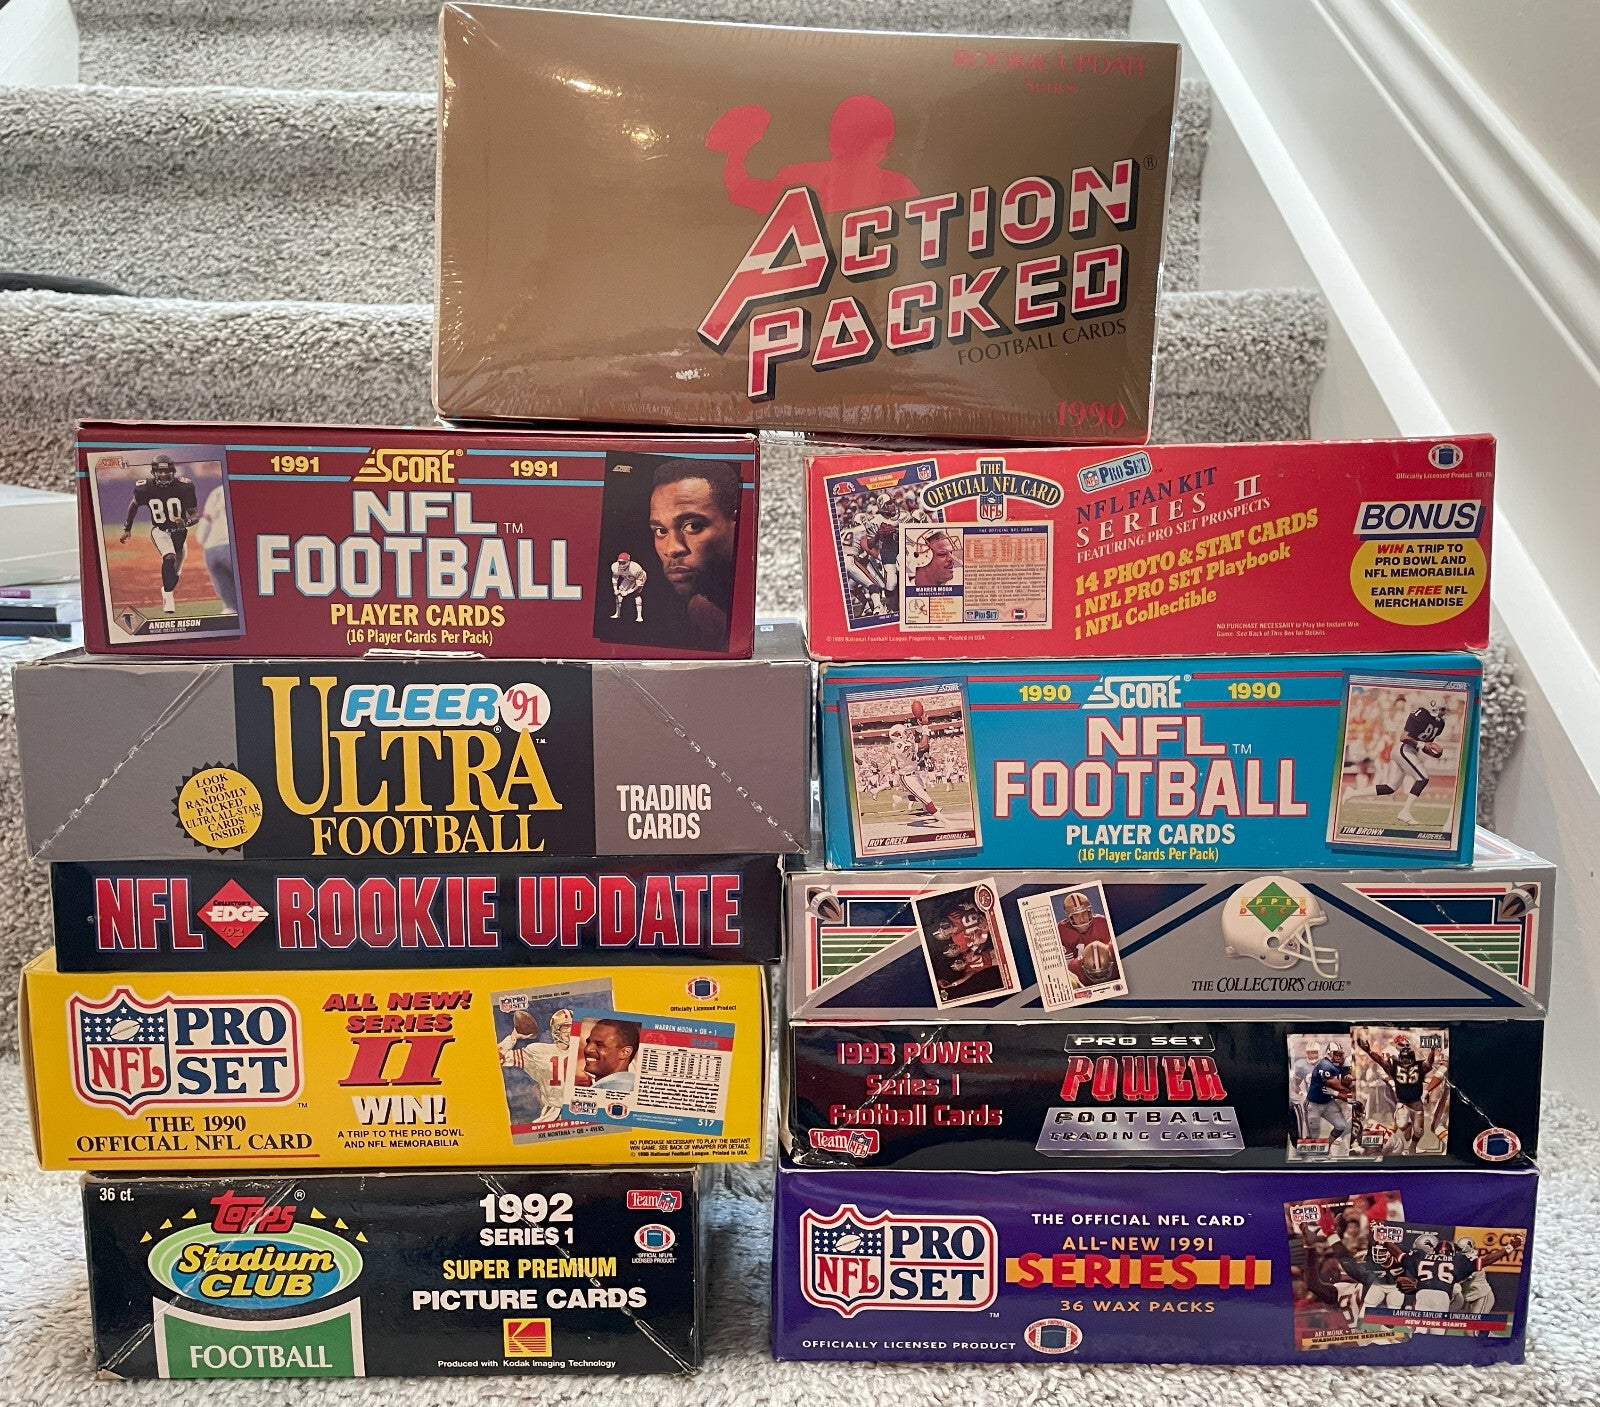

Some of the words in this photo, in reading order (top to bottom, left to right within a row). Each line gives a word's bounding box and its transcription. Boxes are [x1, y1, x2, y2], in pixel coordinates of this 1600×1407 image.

[698, 158, 1139, 353] ACTION
[747, 243, 1128, 402] PACKED
[957, 334, 1058, 366] FOOTBALL
[1062, 318, 1127, 347] CARDS
[1056, 400, 1127, 430] 1990
[270, 456, 321, 473] 1991
[510, 460, 559, 478] 1991
[980, 463, 1002, 475] THE
[1099, 463, 1124, 484] PRO
[1122, 455, 1149, 476] SET
[927, 476, 989, 506] OFFICIAL
[992, 476, 1018, 494] NFL
[1021, 479, 1059, 505] CARD
[1076, 496, 1124, 524] NFL
[1128, 480, 1172, 510] FAN
[1178, 466, 1218, 494] KIT
[352, 490, 498, 536] NFL
[1076, 492, 1206, 549] SERIES
[1234, 474, 1262, 502] II
[1361, 503, 1477, 530] BONUS
[1076, 532, 1144, 564] FEATURING
[1147, 525, 1173, 544] PRO
[1175, 517, 1201, 535] SET
[1201, 497, 1271, 528] PROSPECTS
[1076, 571, 1099, 596] 14
[1103, 551, 1176, 590] PHOTO
[1178, 548, 1193, 566] &
[1196, 529, 1246, 561] STAT
[1248, 508, 1319, 547] CARDS
[1377, 544, 1404, 554] WIN
[1405, 544, 1415, 554] A
[1417, 544, 1445, 553] TRIP
[1447, 543, 1464, 553] TO
[257, 535, 583, 600] FOOTBALL
[1364, 569, 1388, 578] NFL
[1390, 567, 1475, 577] MEMORABILIA
[1375, 556, 1400, 566] PRO
[1403, 556, 1440, 565] BOWL
[1441, 556, 1467, 565] AND
[1085, 592, 1122, 617] NFL
[1124, 578, 1165, 605] PRO
[1169, 569, 1204, 592] SET
[1206, 541, 1292, 582] Playbook
[1371, 587, 1404, 596] EARN
[1407, 585, 1442, 595] FREE
[1445, 585, 1468, 595] NFL
[1085, 613, 1123, 638] NFL
[1125, 586, 1217, 626] Collectible
[1374, 598, 1464, 608] MERCHANDISE
[330, 604, 420, 626] PLAYER
[425, 604, 506, 627] CARDS
[346, 629, 365, 645] (16
[366, 629, 402, 646] Player
[403, 629, 437, 644] Cards
[441, 629, 460, 644] Per
[462, 629, 493, 645] Pack)
[1019, 685, 1072, 702] 1990
[1228, 682, 1281, 699] 1990
[342, 684, 499, 726] FLEER
[506, 688, 542, 726] '91
[262, 676, 563, 816] ULTRA
[1086, 715, 1227, 757] NFL
[195, 773, 229, 788] LOOK
[203, 783, 226, 795] FOR
[994, 758, 1309, 818] FOOTBALL
[185, 787, 247, 809] RANDOMLY
[197, 797, 243, 816] PACKED
[616, 784, 712, 811] TRADING
[186, 815, 217, 829] ULTRA
[218, 803, 261, 821] ALL-STAR
[208, 816, 245, 832] CARDS
[627, 813, 700, 840] CARDS
[211, 825, 248, 841] INSIDE
[311, 814, 545, 857] FOOTBALL
[868, 838, 884, 847] ROY
[885, 836, 909, 846] GREEN
[1066, 824, 1152, 845] PLAYER
[1158, 823, 1236, 845] CARDS
[1342, 826, 1355, 835] TIM
[1355, 828, 1384, 836] BROWN
[1078, 848, 1095, 862] (16
[1098, 848, 1132, 863] Player
[1133, 848, 1166, 861] Cards
[1169, 848, 1187, 861] Per
[1188, 847, 1219, 862] Pack)
[95, 877, 205, 951] NFL
[276, 876, 499, 950] ROOKIE
[518, 875, 742, 948] UPDATE
[206, 906, 269, 922] EDGE
[1239, 907, 1307, 916] DECK
[1192, 980, 1214, 991] THE
[1217, 977, 1306, 992] COLLECTOR'S
[1308, 980, 1346, 991] CHOICE
[322, 992, 379, 1012] ALL
[385, 990, 473, 1011] NEW!
[345, 1012, 455, 1034] SERIES
[88, 1047, 165, 1094] NFL
[174, 1006, 287, 1046] PRO
[837, 1043, 896, 1064] 1993
[903, 1041, 993, 1064] POWER
[1074, 1037, 1136, 1046] PRO
[1151, 1036, 1204, 1046] SET
[338, 1036, 457, 1087] II
[177, 1056, 288, 1095] SET
[866, 1073, 940, 1096] Series
[1060, 1055, 1228, 1101] POWER
[351, 1094, 447, 1125] WIN!
[829, 1104, 927, 1125] Football
[933, 1104, 1002, 1126] Cards
[1055, 1111, 1232, 1125] FOOTBALL
[145, 1116, 194, 1132] THE
[203, 1115, 246, 1132] 1990
[337, 1130, 344, 1138] A
[347, 1130, 369, 1138] TRIP
[389, 1129, 408, 1137] THE
[434, 1128, 464, 1136] BOWL
[76, 1135, 188, 1152] OFFICIAL
[195, 1136, 241, 1151] NFL
[248, 1134, 313, 1150] CARD
[344, 1140, 365, 1148] AND
[389, 1139, 459, 1147] MEMORABILIA
[1049, 1131, 1149, 1140] TRADING
[1160, 1131, 1236, 1141] CARDS
[99, 1188, 116, 1201] 36
[120, 1187, 135, 1201] ct.
[632, 1193, 658, 1207] Team
[479, 1192, 574, 1223] 1992
[1031, 1214, 1064, 1225] THE
[1071, 1214, 1151, 1226] OFFICIAL
[1157, 1215, 1190, 1226] NFL
[1197, 1215, 1245, 1226] CARD
[479, 1228, 560, 1246] SERIES
[564, 1228, 574, 1244] 1
[1063, 1236, 1160, 1250] ALL-NEW
[1170, 1237, 1214, 1251] 1991
[177, 1242, 335, 1273] Stadium
[442, 1259, 510, 1280] SUPER
[518, 1257, 617, 1278] PREMIUM
[817, 1257, 880, 1297] NFL
[890, 1226, 986, 1261] PRO
[1017, 1253, 1198, 1290] SERIES
[1219, 1255, 1256, 1290] II
[1418, 1261, 1454, 1284] 56
[200, 1273, 313, 1298] CLUB
[890, 1268, 985, 1301] SET
[412, 1290, 537, 1310] PICTURE
[547, 1287, 647, 1309] CARDS
[1060, 1301, 1084, 1312] 36
[1093, 1301, 1140, 1312] WAX
[1148, 1301, 1216, 1313] PACKS
[1392, 1310, 1422, 1318] LAWRENCE
[1422, 1311, 1443, 1319] TAYLOR
[1449, 1313, 1482, 1321] LINEBACKER
[190, 1345, 333, 1368] FOOTBALL
[802, 1340, 879, 1349] OFFICIALLY
[883, 1340, 949, 1349] LICENSED
[952, 1341, 1017, 1350] PRODUCT
[437, 1360, 478, 1368] Produced
[532, 1360, 566, 1369] Imaging
[568, 1359, 616, 1368] Technology
